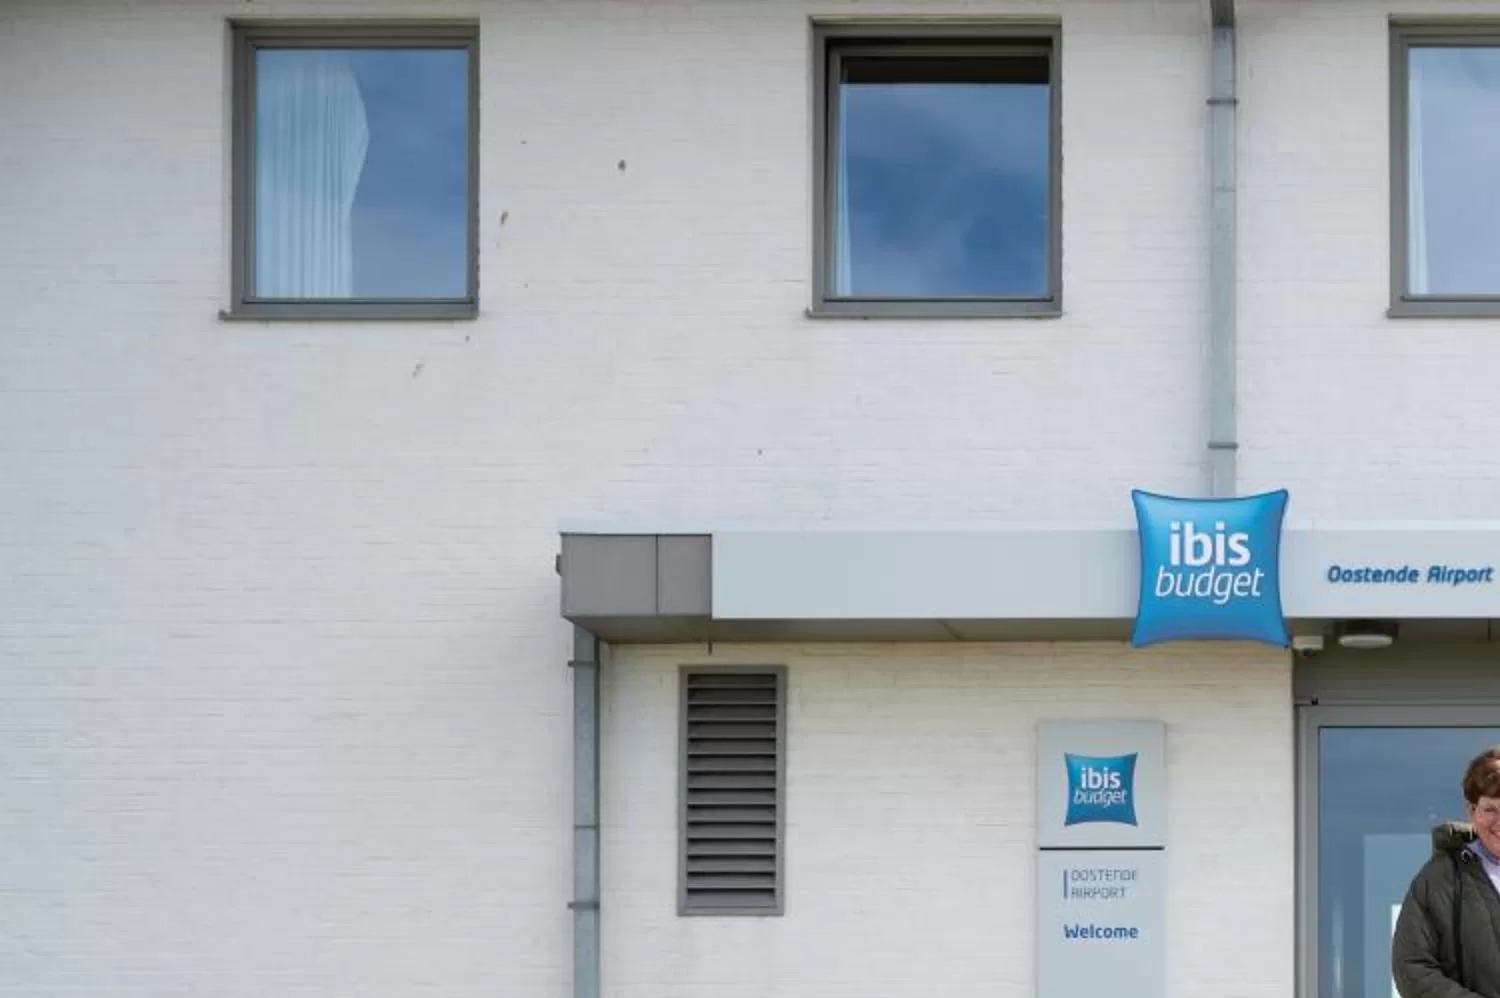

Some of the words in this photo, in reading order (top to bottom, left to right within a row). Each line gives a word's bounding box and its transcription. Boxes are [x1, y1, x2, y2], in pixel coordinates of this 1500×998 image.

[1169, 521, 1252, 566] ibis
[1154, 565, 1265, 604] budget
[1327, 566, 1420, 585] Oostende
[1427, 566, 1494, 588] Airport
[1081, 767, 1121, 789] ibis
[1073, 788, 1127, 808] budget
[1070, 887, 1127, 901] AIRPORT
[1063, 924, 1139, 939] Welcome
